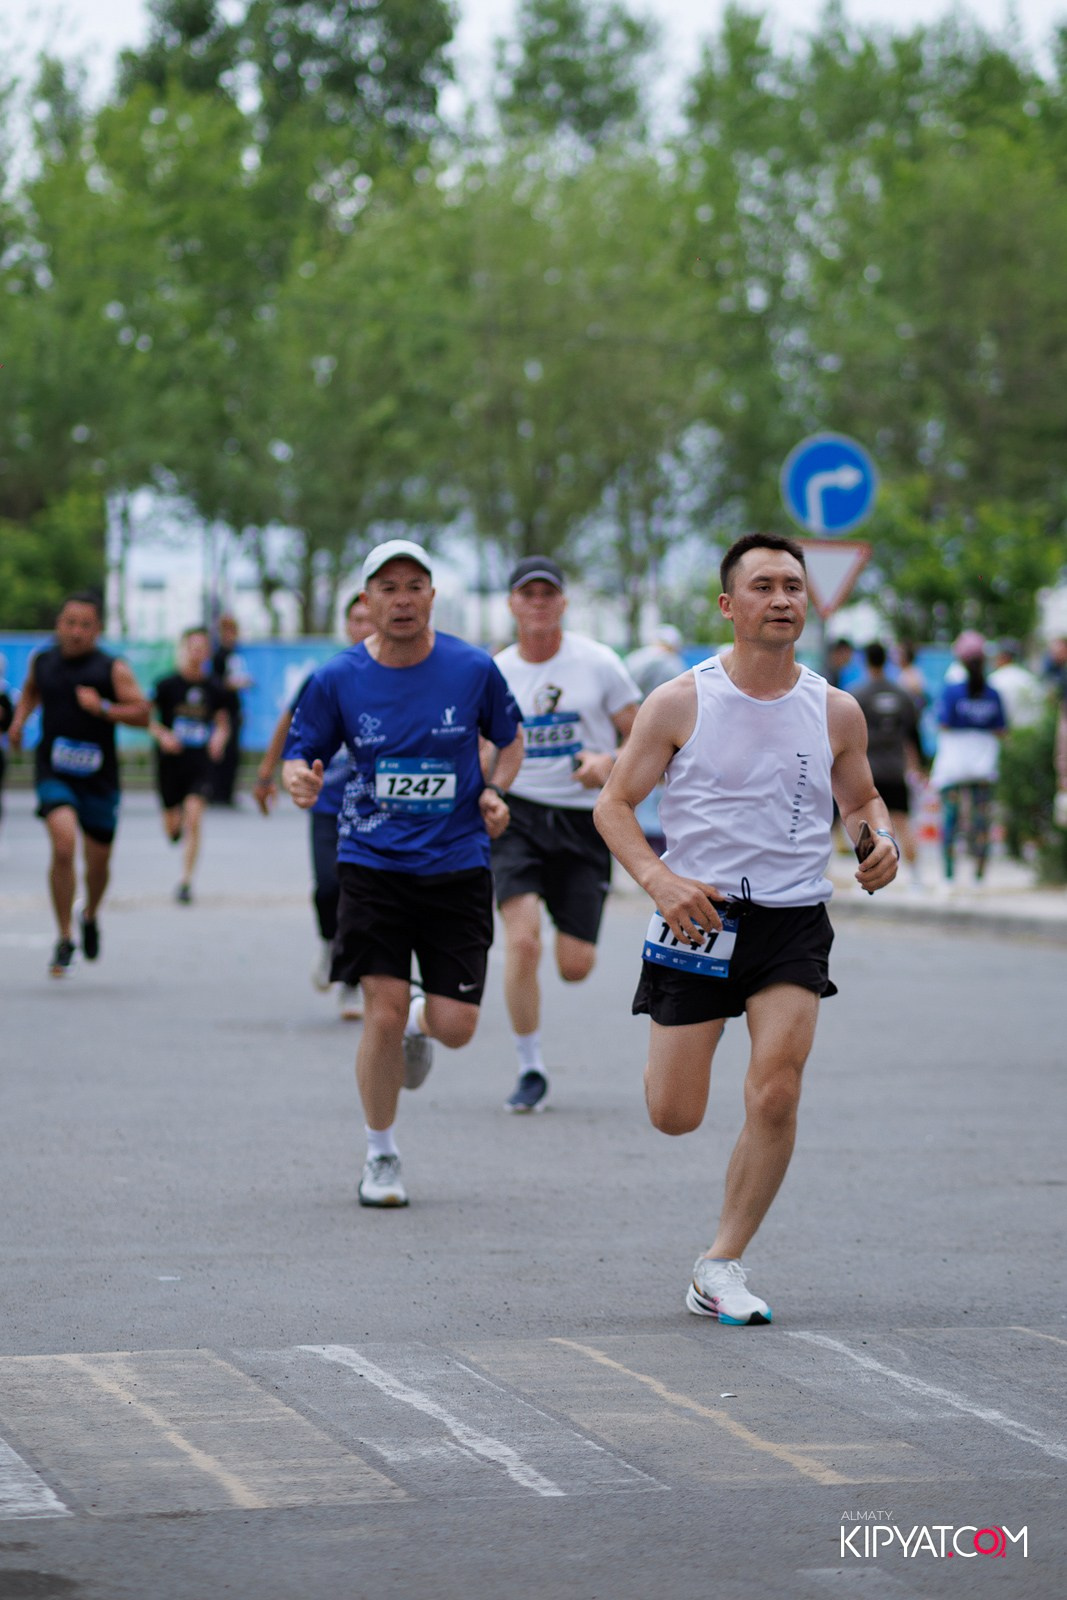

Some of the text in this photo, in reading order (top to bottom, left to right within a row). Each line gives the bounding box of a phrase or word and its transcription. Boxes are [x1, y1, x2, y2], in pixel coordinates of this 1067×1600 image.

[387, 777, 447, 796] 1247
[789, 759, 808, 841] NIKE RUNNING
